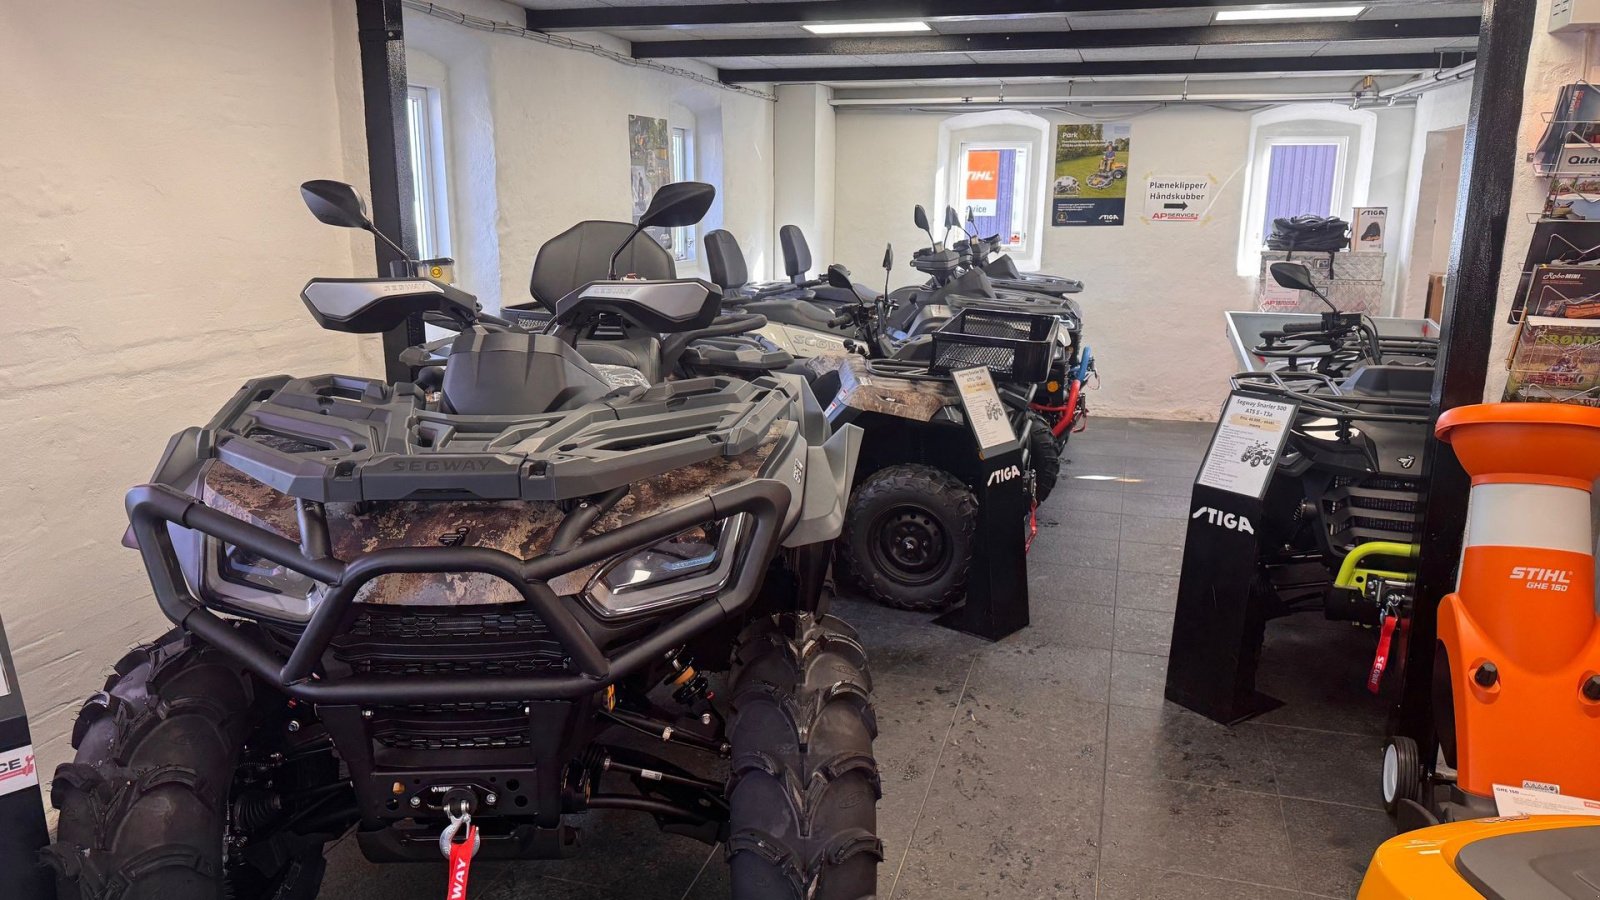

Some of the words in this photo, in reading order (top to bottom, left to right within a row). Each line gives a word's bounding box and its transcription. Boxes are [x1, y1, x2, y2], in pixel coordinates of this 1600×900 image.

[1568, 155, 1600, 165] Qua
[1149, 181, 1207, 190] Plæneklipper/
[1150, 192, 1205, 200] Håndskubber
[1237, 398, 1256, 407] Segway
[1257, 401, 1276, 409] Snarler
[392, 460, 491, 472] SEGWAY
[987, 464, 1021, 488] STIGA
[1192, 506, 1255, 535] STIGA
[1509, 566, 1571, 584] STIHL
[1526, 581, 1549, 590] GHE
